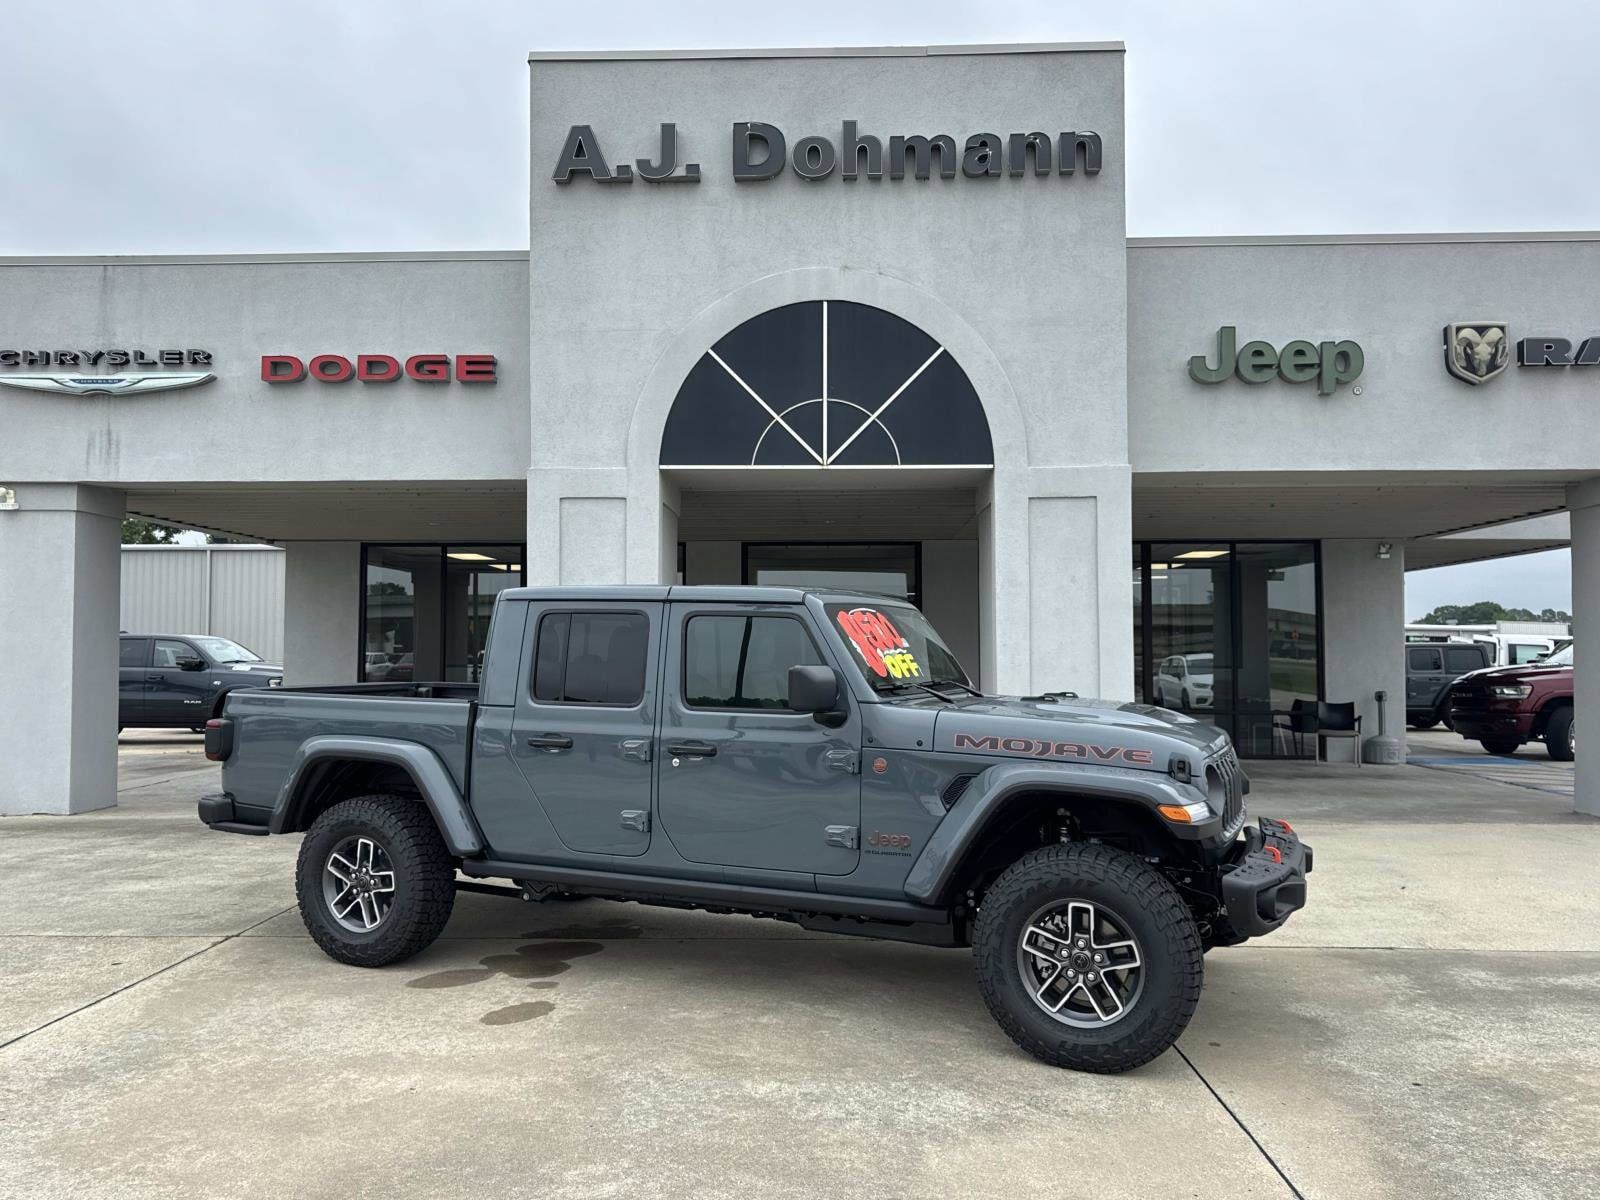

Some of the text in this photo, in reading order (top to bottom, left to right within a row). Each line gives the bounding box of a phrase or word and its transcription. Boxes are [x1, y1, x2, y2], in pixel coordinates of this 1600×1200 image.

[551, 120, 1103, 184] A.J. Dohmann
[0, 349, 213, 366] CHRYSLER
[261, 354, 498, 385] DODGE
[1188, 326, 1365, 396] Jeep
[884, 653, 920, 679] OFF
[953, 733, 1153, 764] MOJAVE
[867, 830, 912, 848] Jeep
